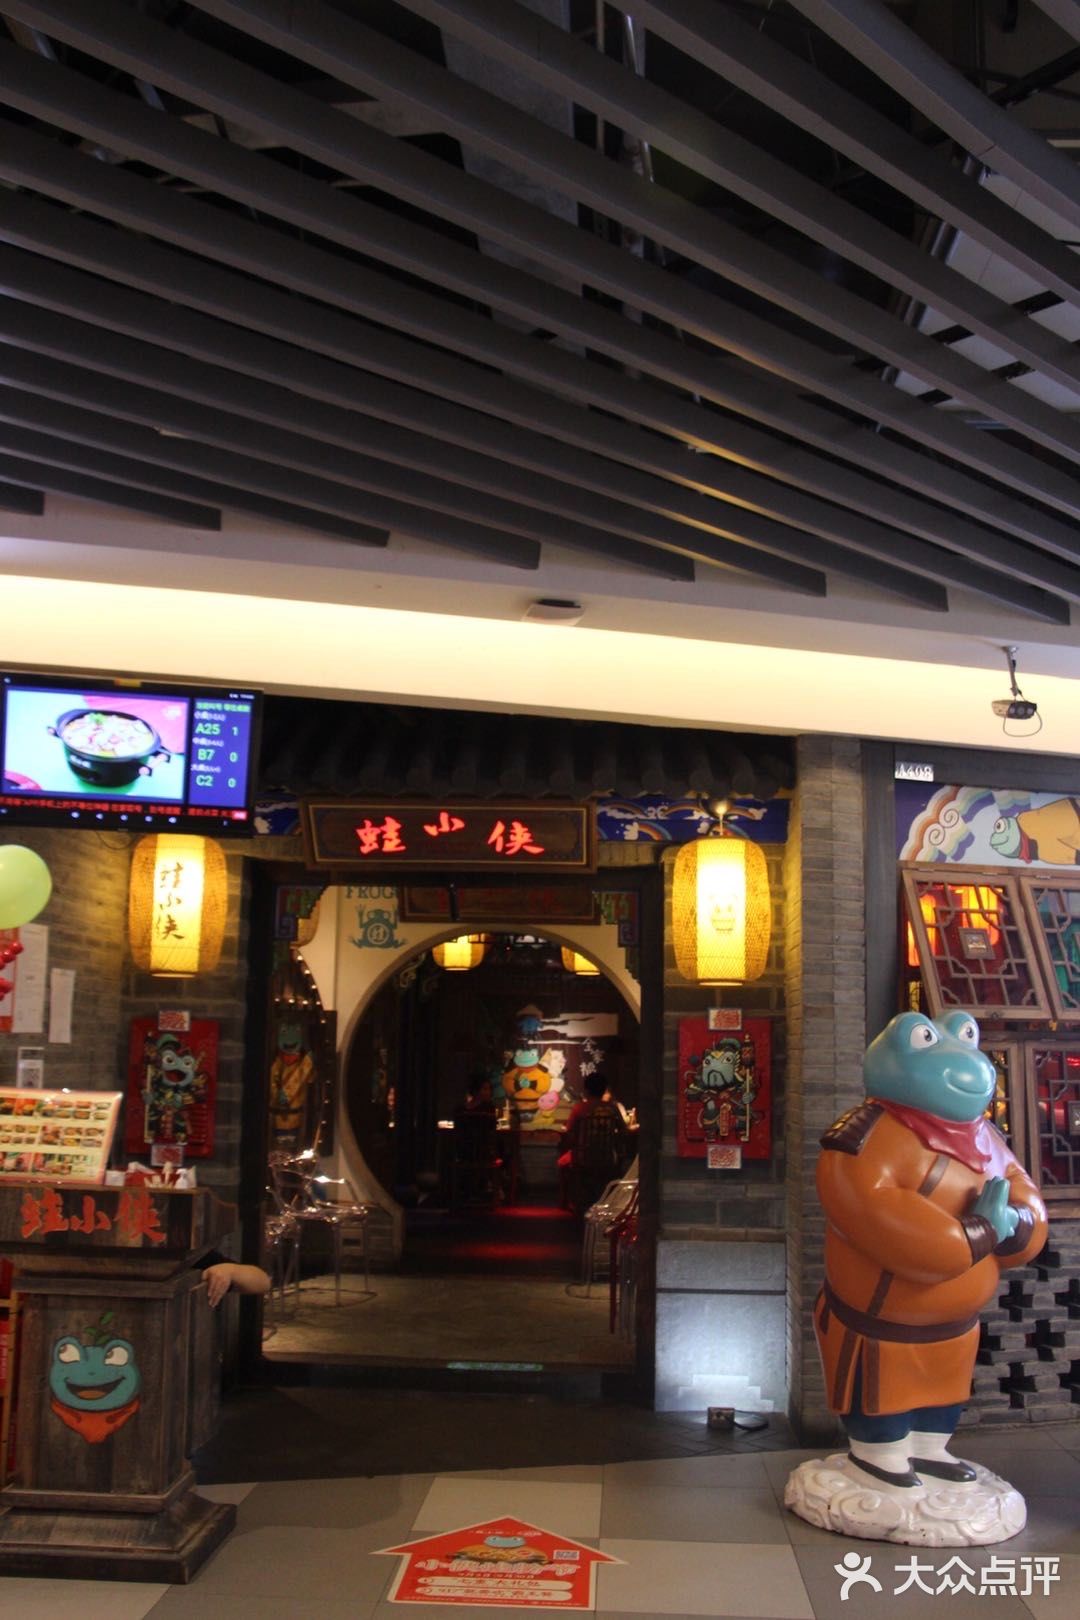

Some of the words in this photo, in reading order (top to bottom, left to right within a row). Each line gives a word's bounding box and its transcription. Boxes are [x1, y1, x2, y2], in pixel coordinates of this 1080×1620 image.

[195, 723, 221, 735] A25
[232, 726, 238, 736] 1
[198, 748, 215, 761] B7
[229, 751, 238, 763] 0
[196, 775, 213, 787] C2
[228, 778, 236, 788] 0
[355, 811, 546, 856] 蛙小侠
[21, 1187, 167, 1243] 蛙小侠
